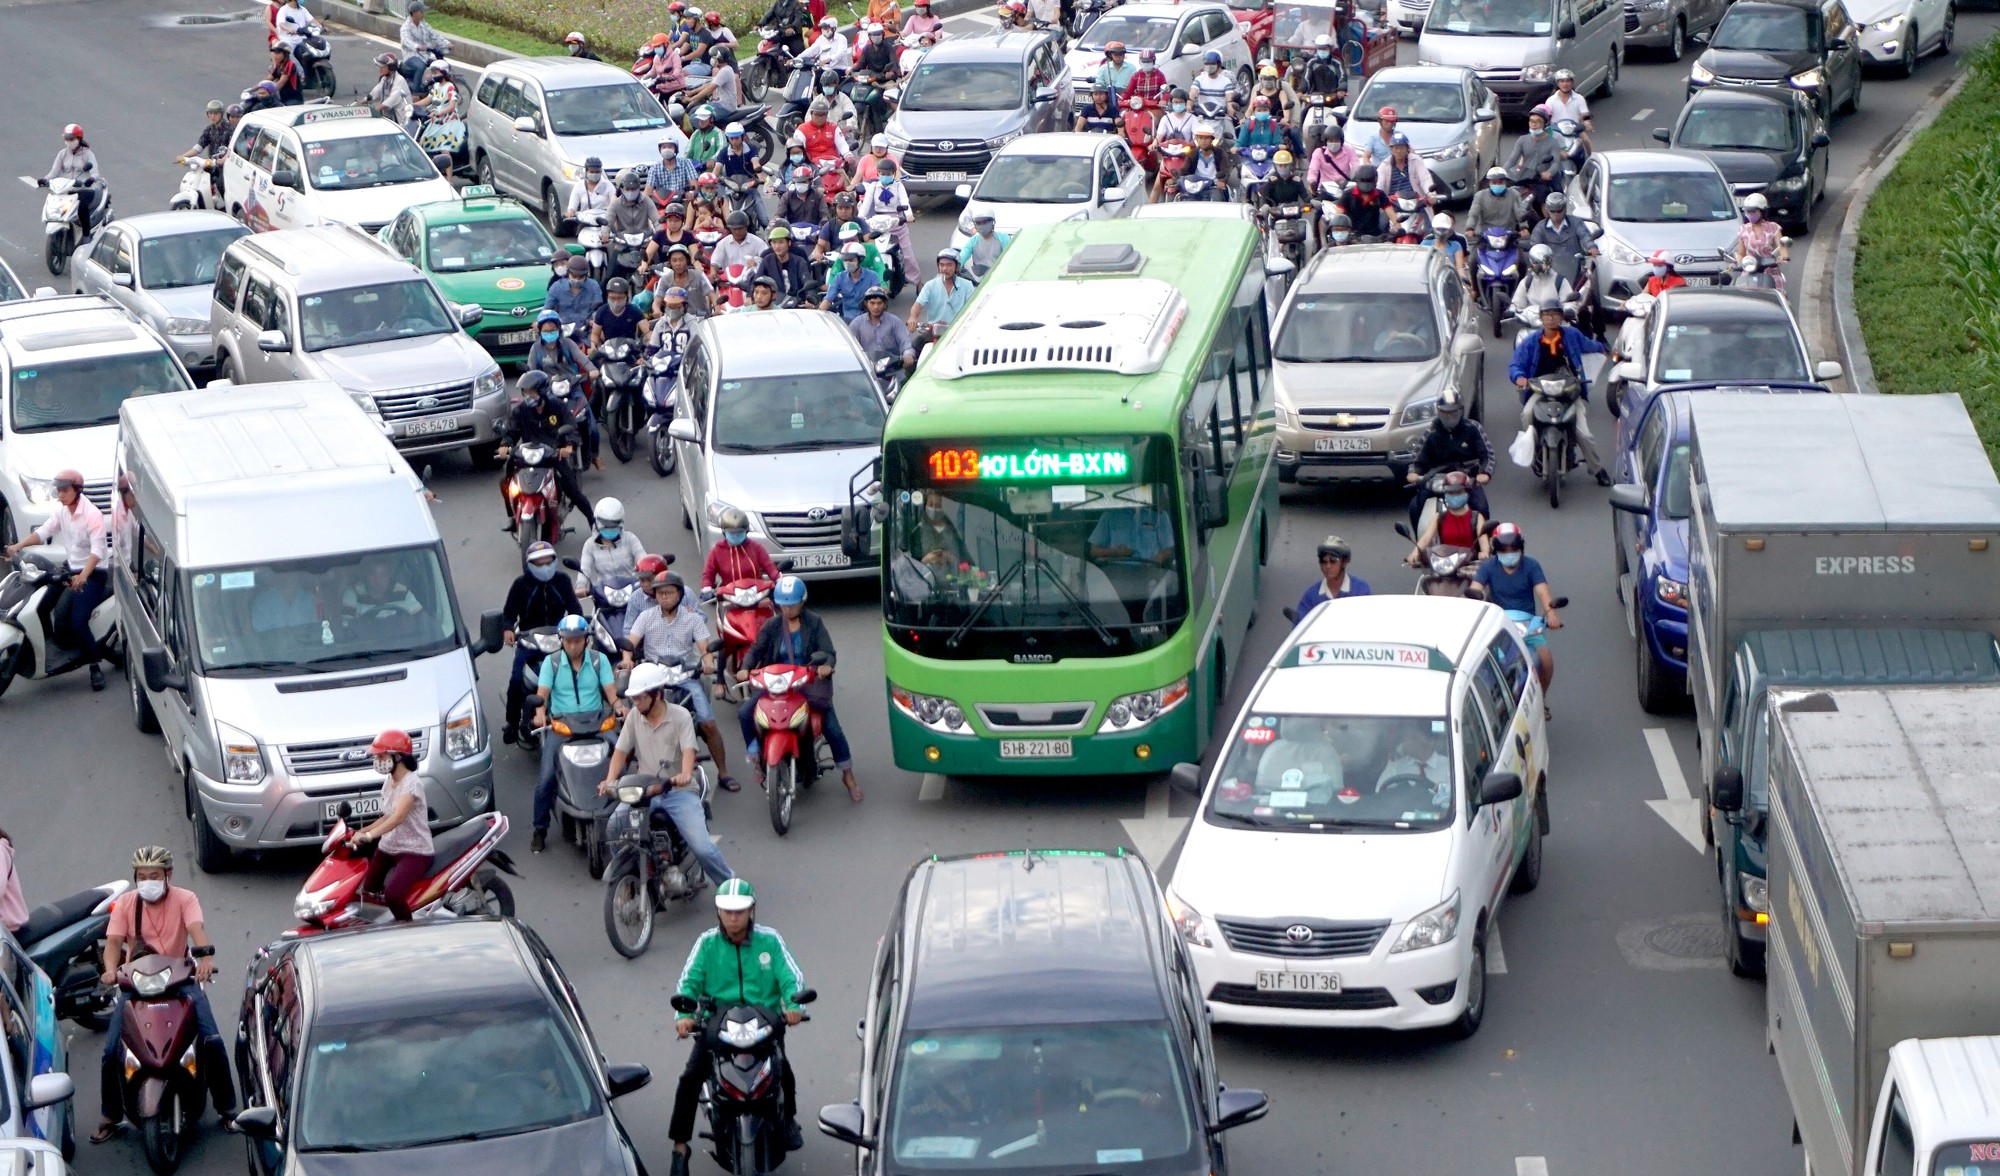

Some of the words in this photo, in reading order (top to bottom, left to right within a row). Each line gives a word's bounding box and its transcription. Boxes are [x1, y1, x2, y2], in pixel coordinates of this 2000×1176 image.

[321, 109, 353, 119] VINASUN
[353, 108, 369, 117] TAXI
[408, 418, 455, 435] 56S-5478
[929, 449, 980, 479] 103
[1815, 555, 1916, 574] EXPRESS
[1013, 654, 1053, 663] SAMCO
[1331, 647, 1394, 661] VINASUN
[1398, 649, 1426, 664] TAXI
